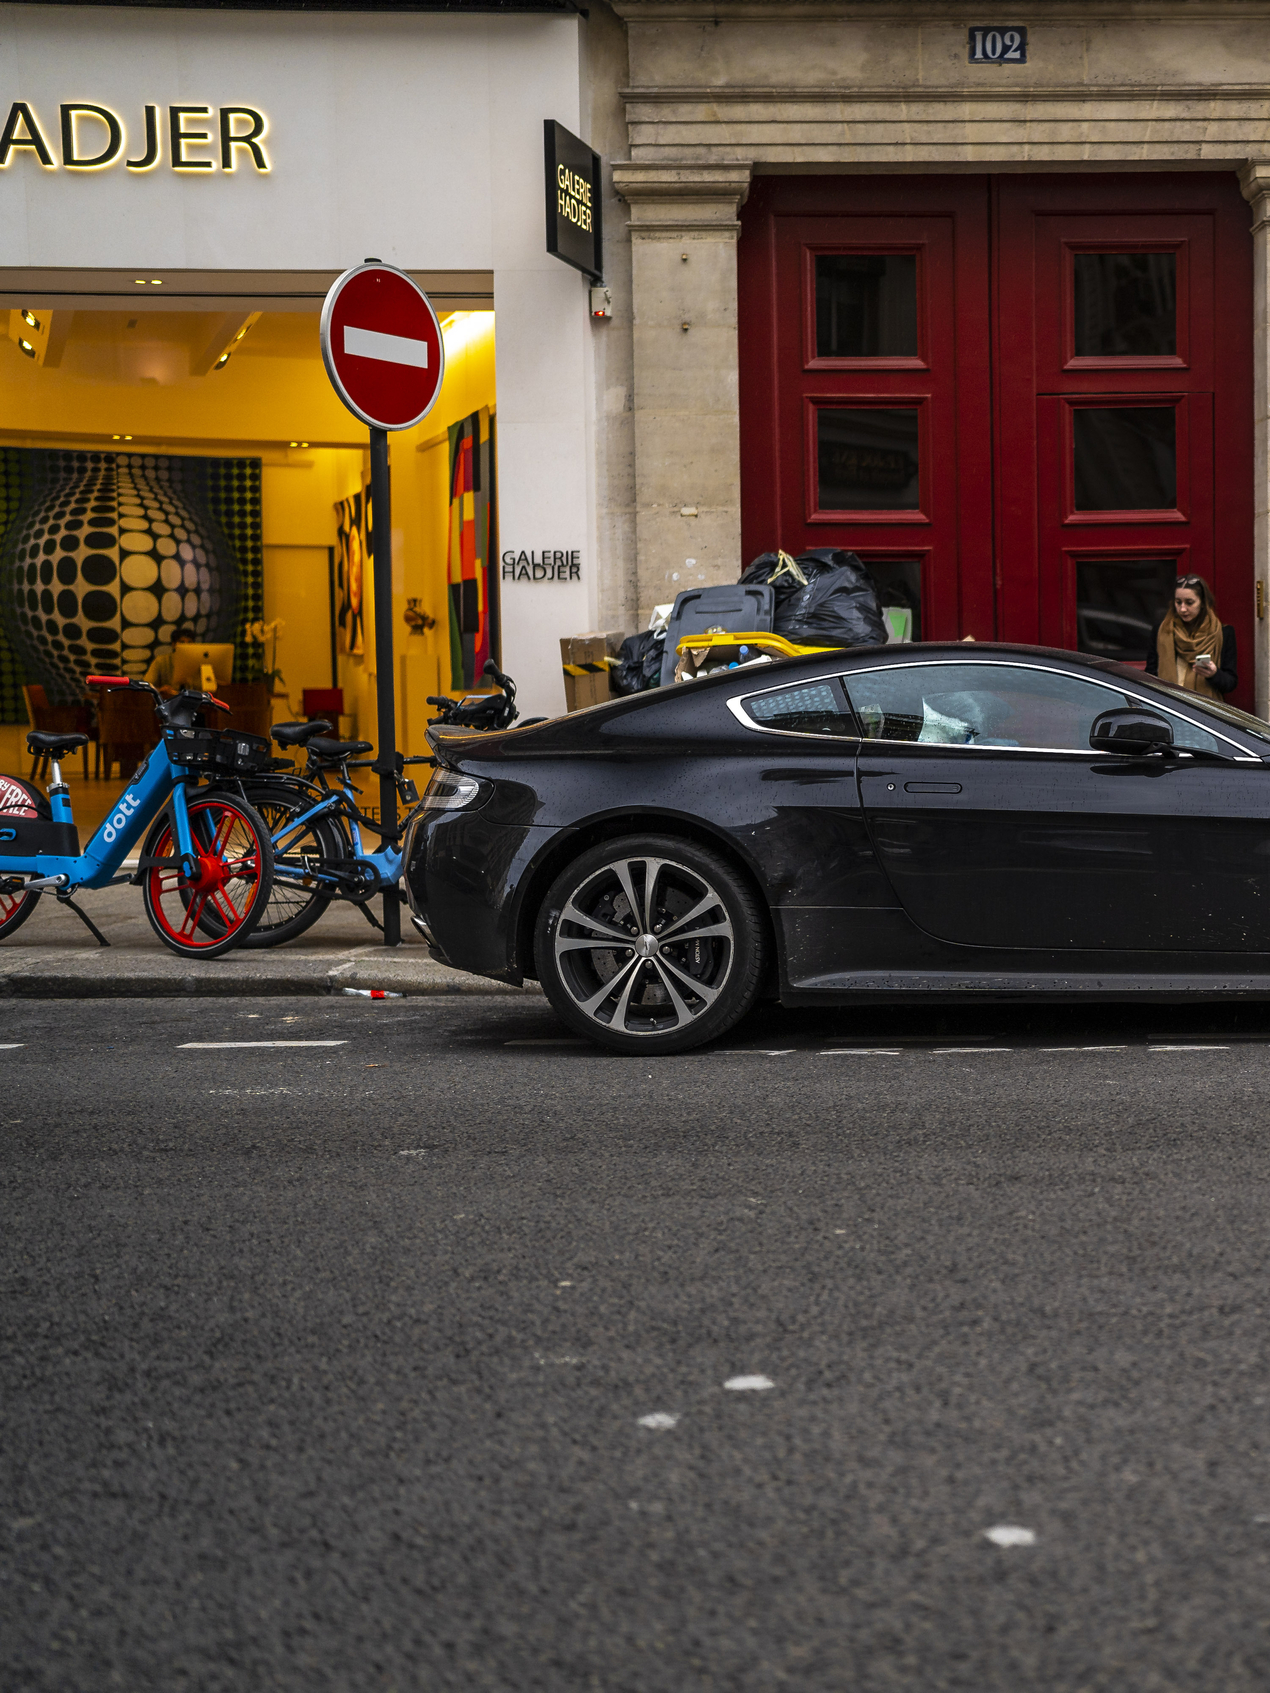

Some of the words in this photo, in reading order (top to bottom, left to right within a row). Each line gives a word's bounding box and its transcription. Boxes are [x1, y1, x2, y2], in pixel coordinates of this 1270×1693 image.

[973, 31, 1021, 59] 102
[557, 163, 592, 208] GALERIE
[557, 189, 593, 234] HADJER
[502, 550, 581, 566] GALERIE
[502, 565, 581, 581] HADJER
[103, 793, 141, 843] dott
